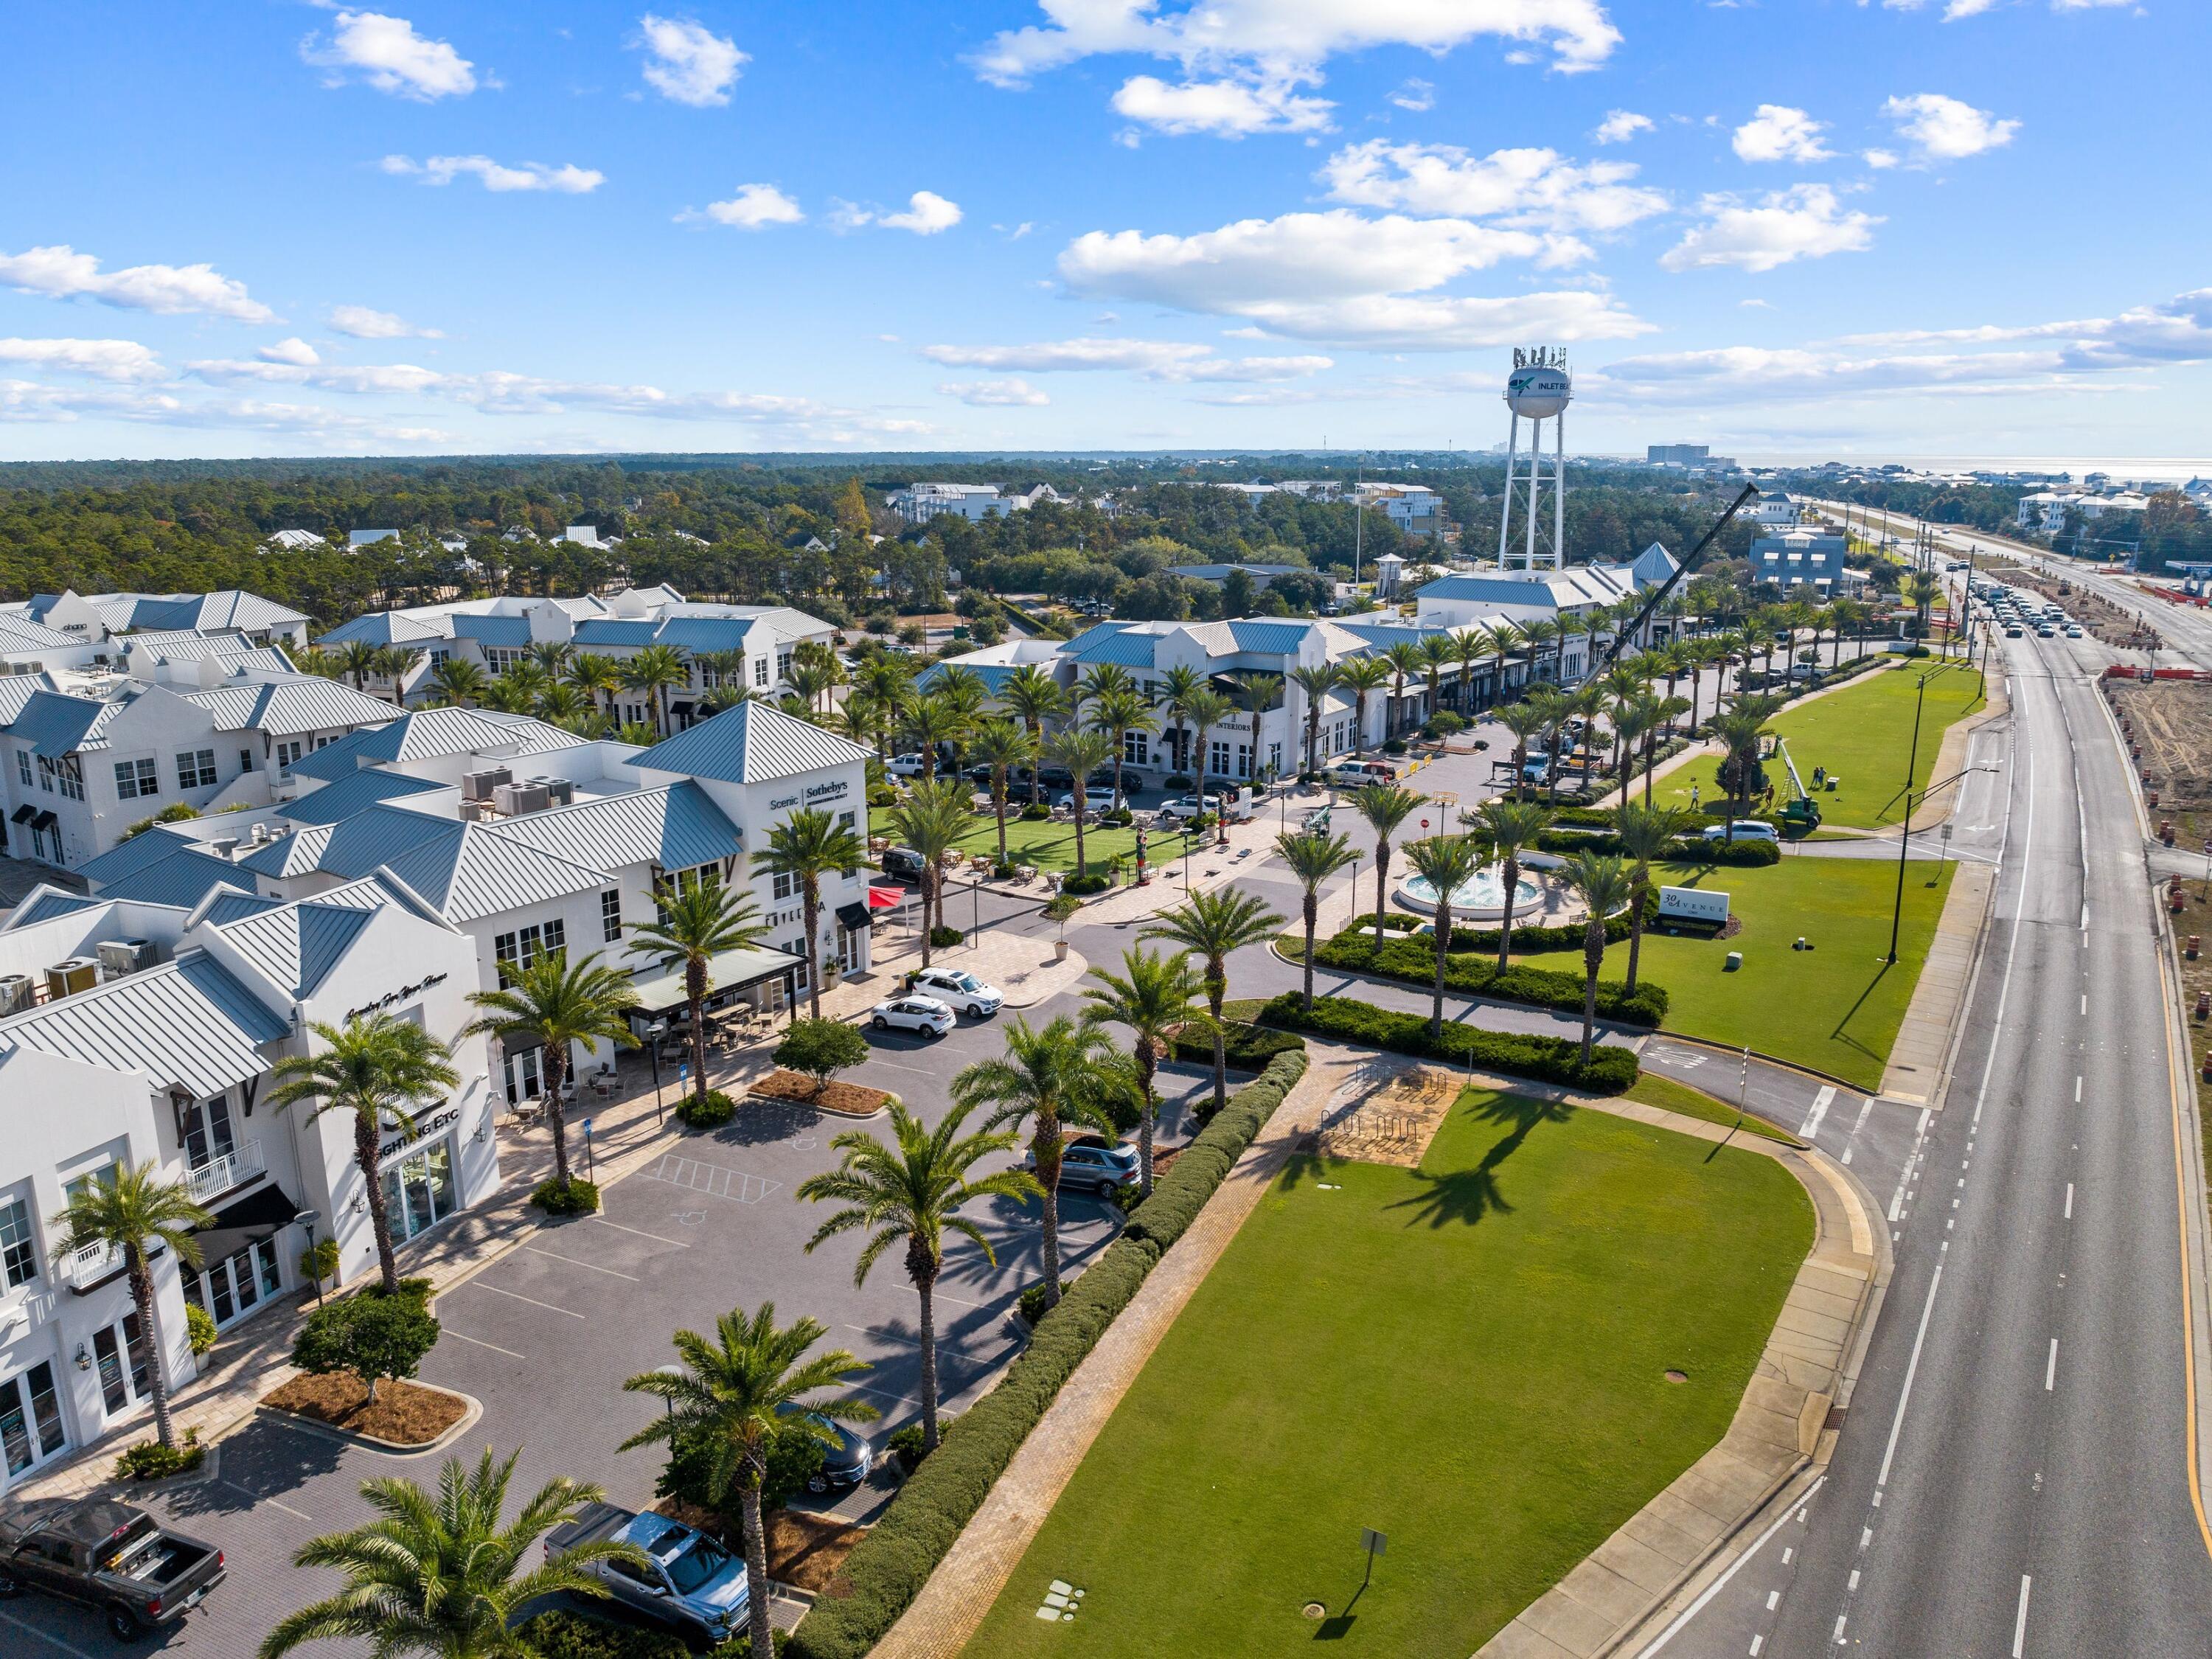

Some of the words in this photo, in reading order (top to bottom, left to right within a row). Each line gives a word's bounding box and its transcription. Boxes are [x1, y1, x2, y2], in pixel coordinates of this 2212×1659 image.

[1217, 723, 1251, 732] INTERIORS
[807, 780, 848, 799] Sotheby's
[771, 796, 799, 810] Scenic
[401, 985, 421, 999] Your
[424, 973, 448, 987] Home
[377, 1124, 431, 1161] IGHTNG
